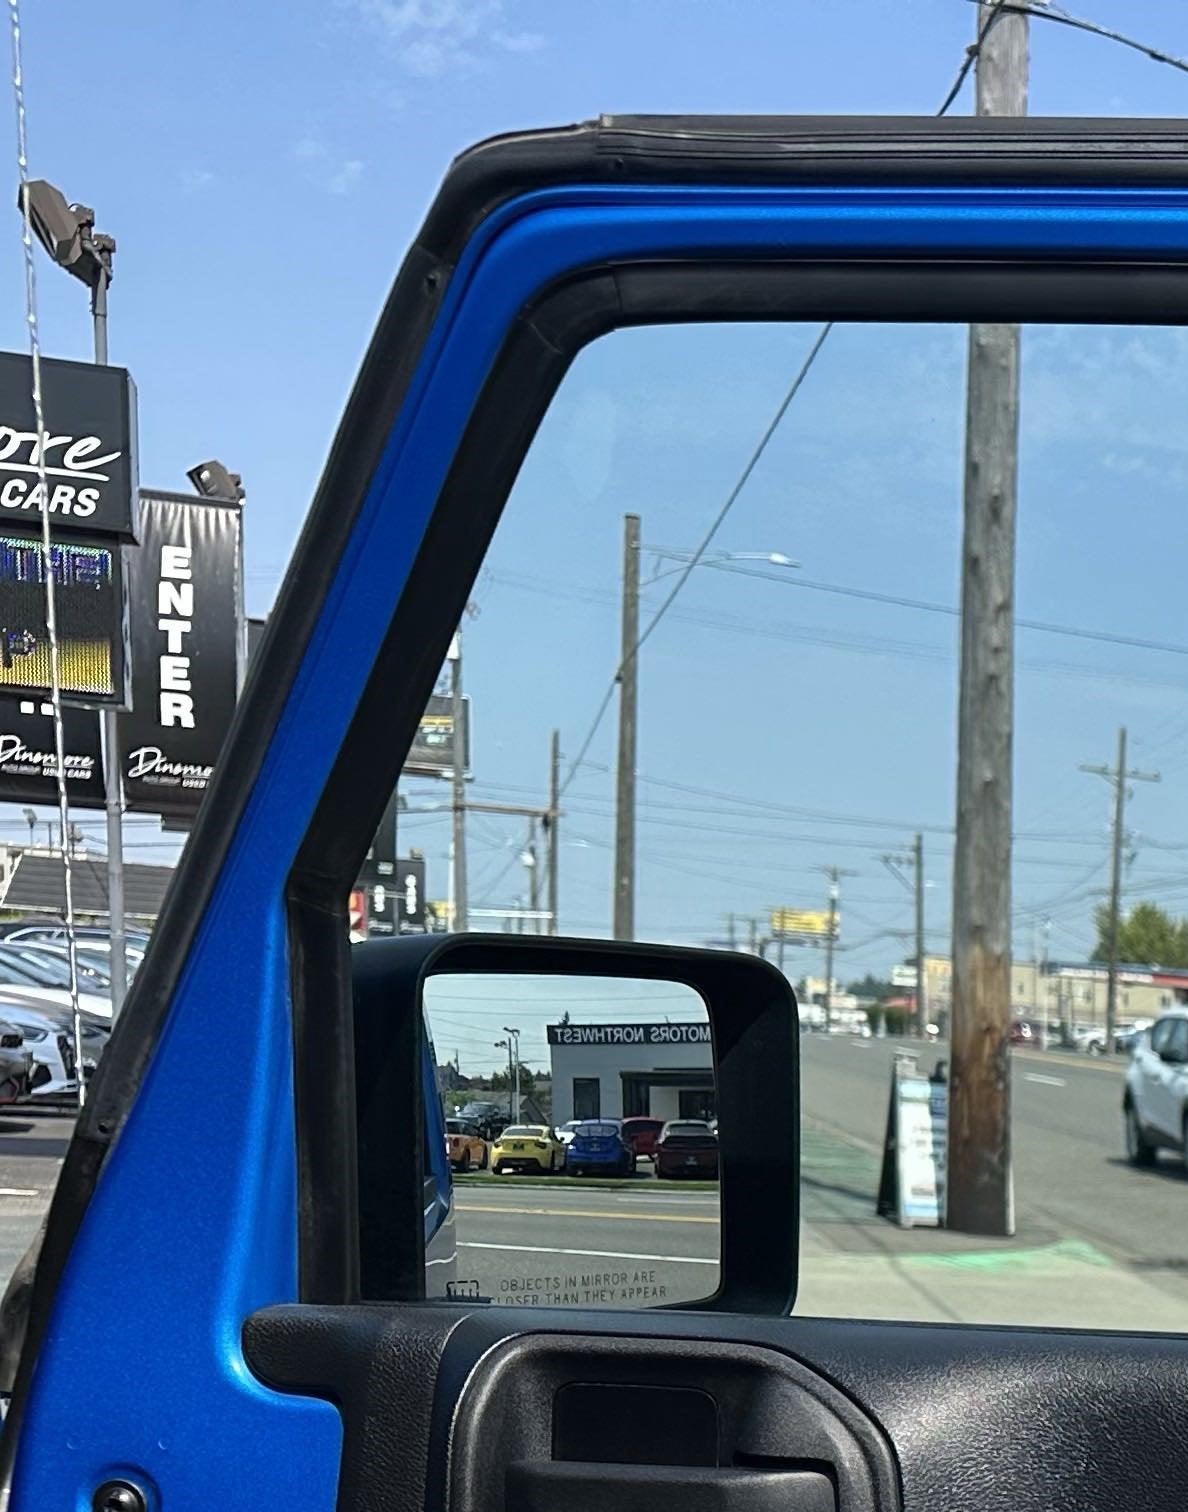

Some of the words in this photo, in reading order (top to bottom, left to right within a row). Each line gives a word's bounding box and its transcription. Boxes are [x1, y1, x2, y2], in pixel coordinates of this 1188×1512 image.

[0, 478, 100, 517] CARS
[158, 545, 195, 728] ENTER
[501, 1277, 561, 1292] OBJECTS
[565, 1275, 577, 1288] IN
[582, 1272, 628, 1286] MIRROR
[633, 1270, 656, 1283] ARE
[547, 1292, 579, 1304] THAN
[584, 1289, 615, 1302] THEY
[621, 1286, 667, 1299] APPEAR
